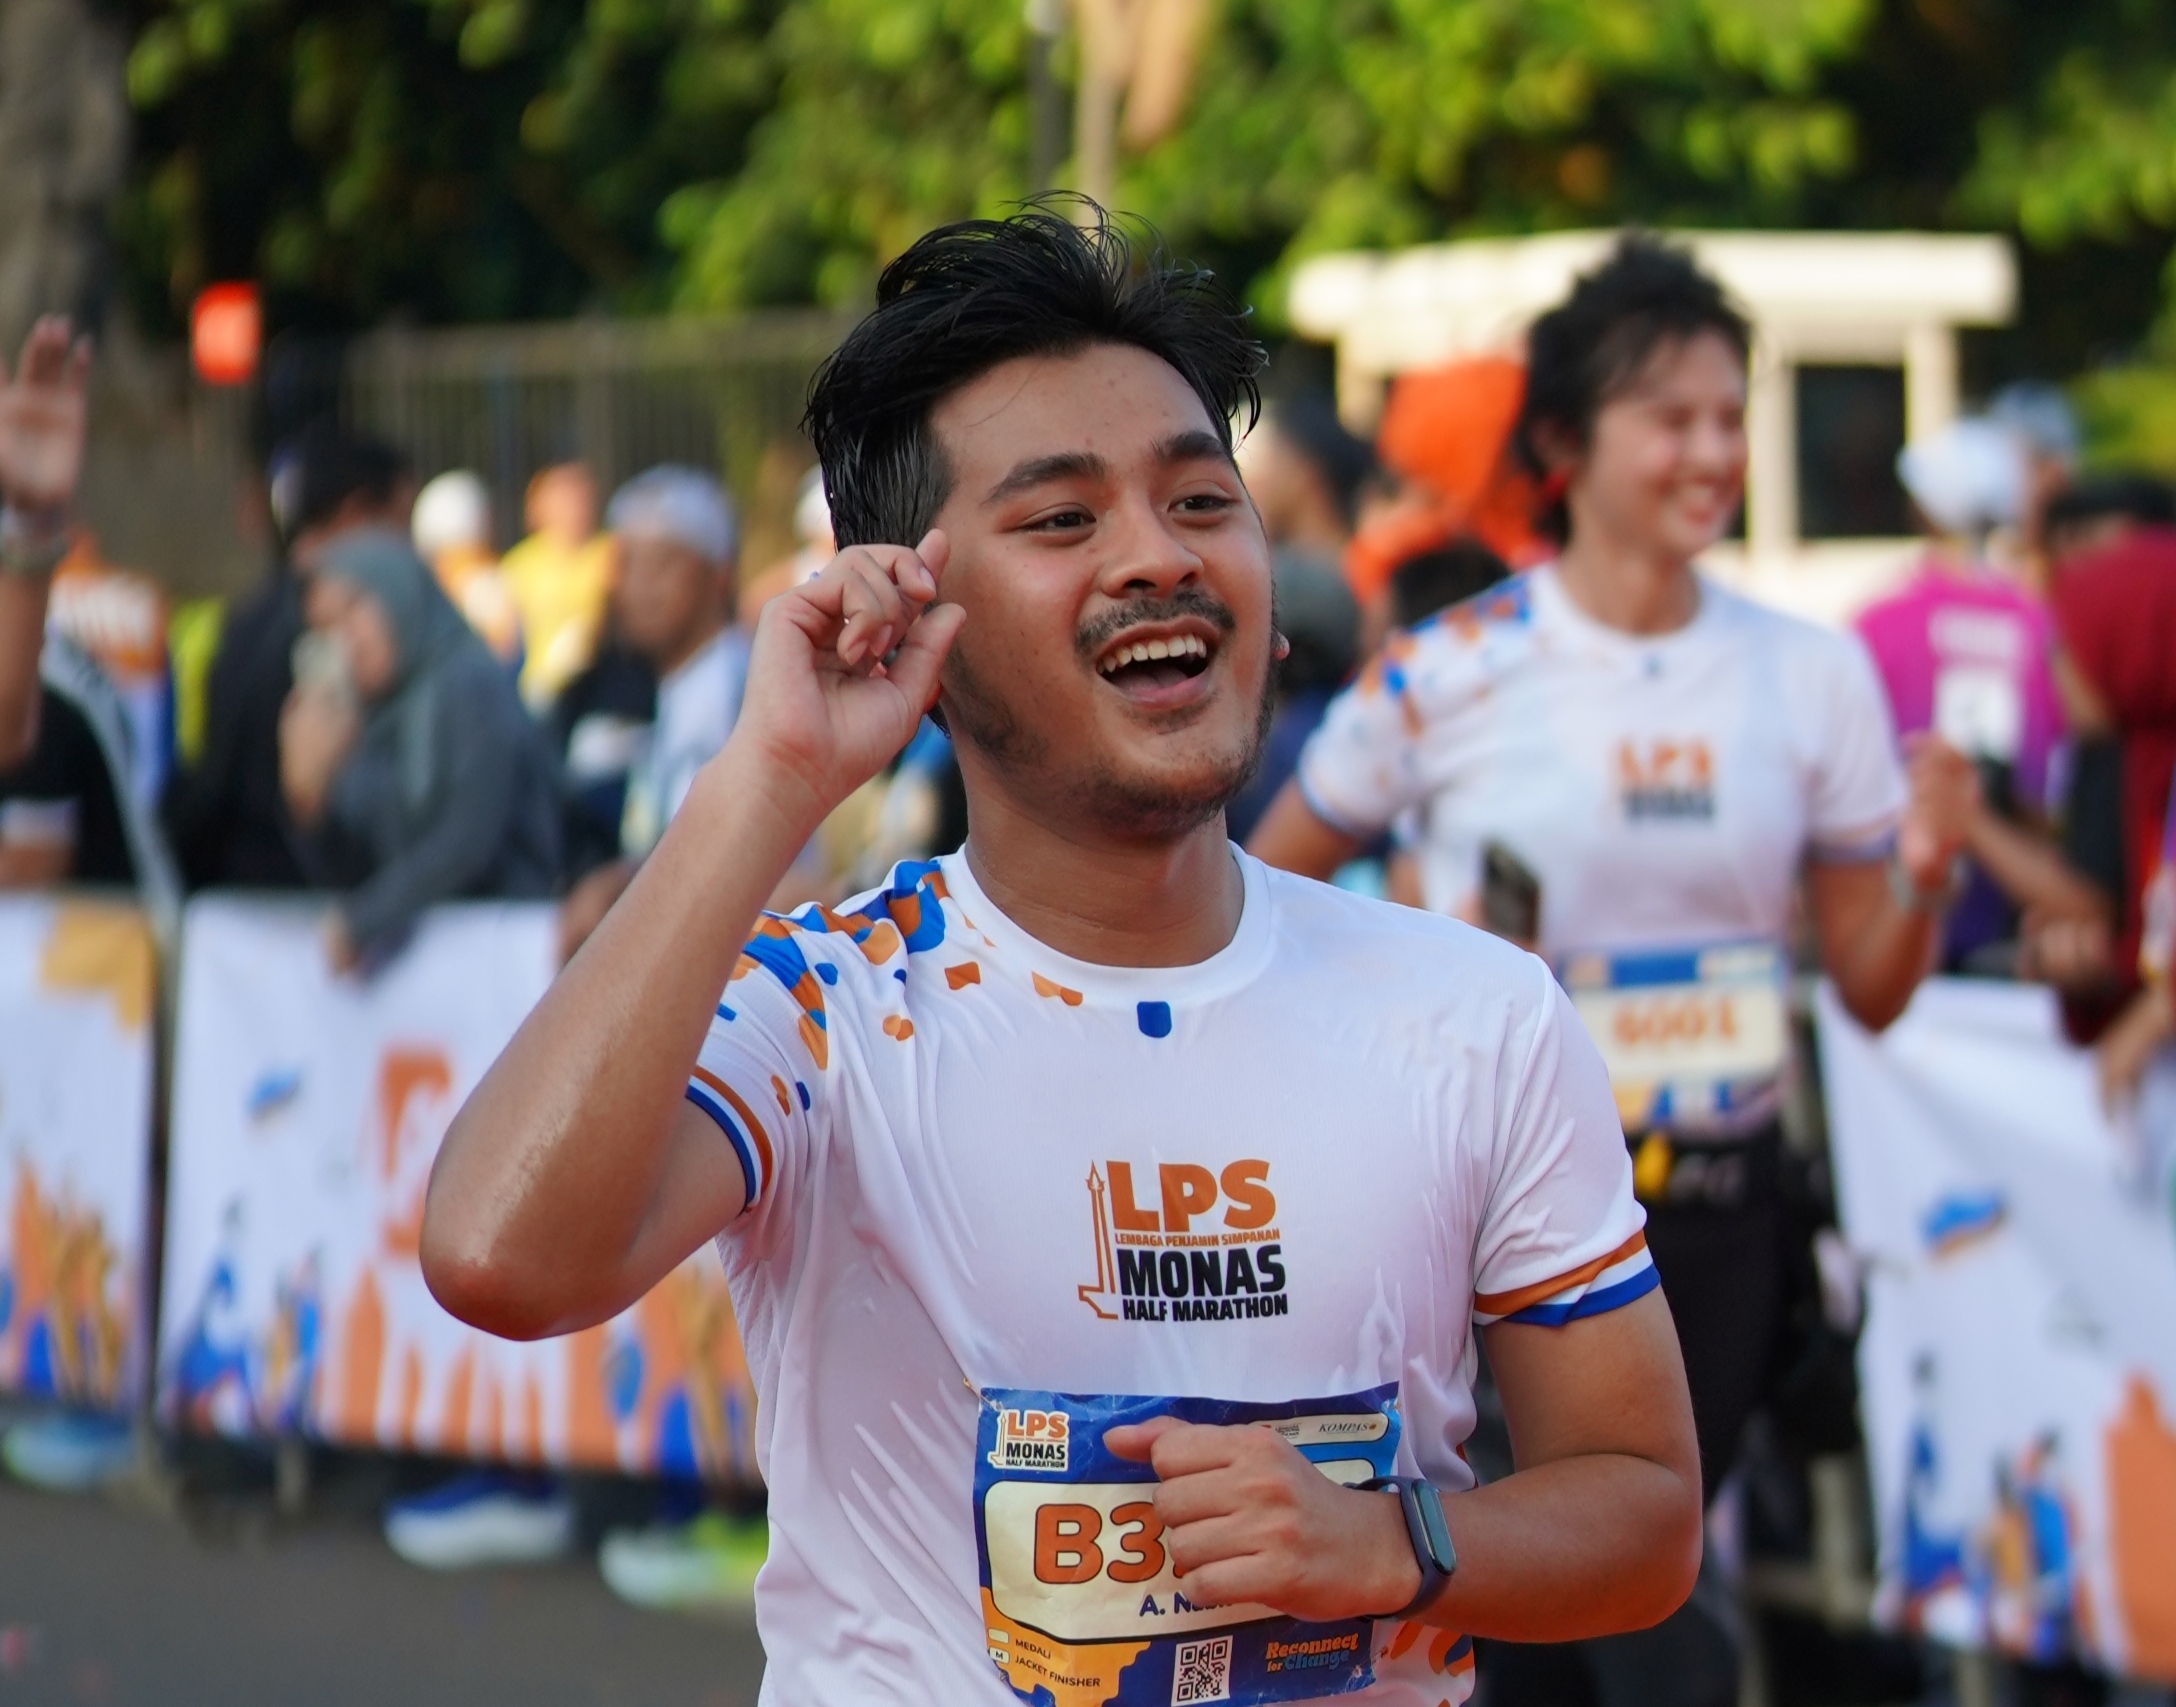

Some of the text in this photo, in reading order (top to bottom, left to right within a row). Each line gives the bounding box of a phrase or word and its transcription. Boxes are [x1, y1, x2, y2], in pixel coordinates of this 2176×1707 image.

[1106, 1159, 1276, 1233] LPS
[1115, 1228, 1281, 1247] LEMBAGA PENJAMIN SIMPANAN
[1116, 1244, 1286, 1298] MONAS
[1122, 1293, 1288, 1322] HALF MARATHON
[1007, 1412, 1066, 1438] LPS
[1318, 1422, 1369, 1433] KOMPAS
[1006, 1442, 1066, 1460] MONAS
[1025, 1459, 1066, 1468] MARATHON
[1033, 1502, 1191, 1584] B3
[1139, 1594, 1166, 1617] A.
[995, 1651, 1004, 1660] M
[1015, 1639, 1051, 1660] MEDALI
[1265, 1632, 1359, 1660] Reconnect
[1014, 1655, 1101, 1687] JACKET FINISHER
[1266, 1650, 1350, 1673] for Change
